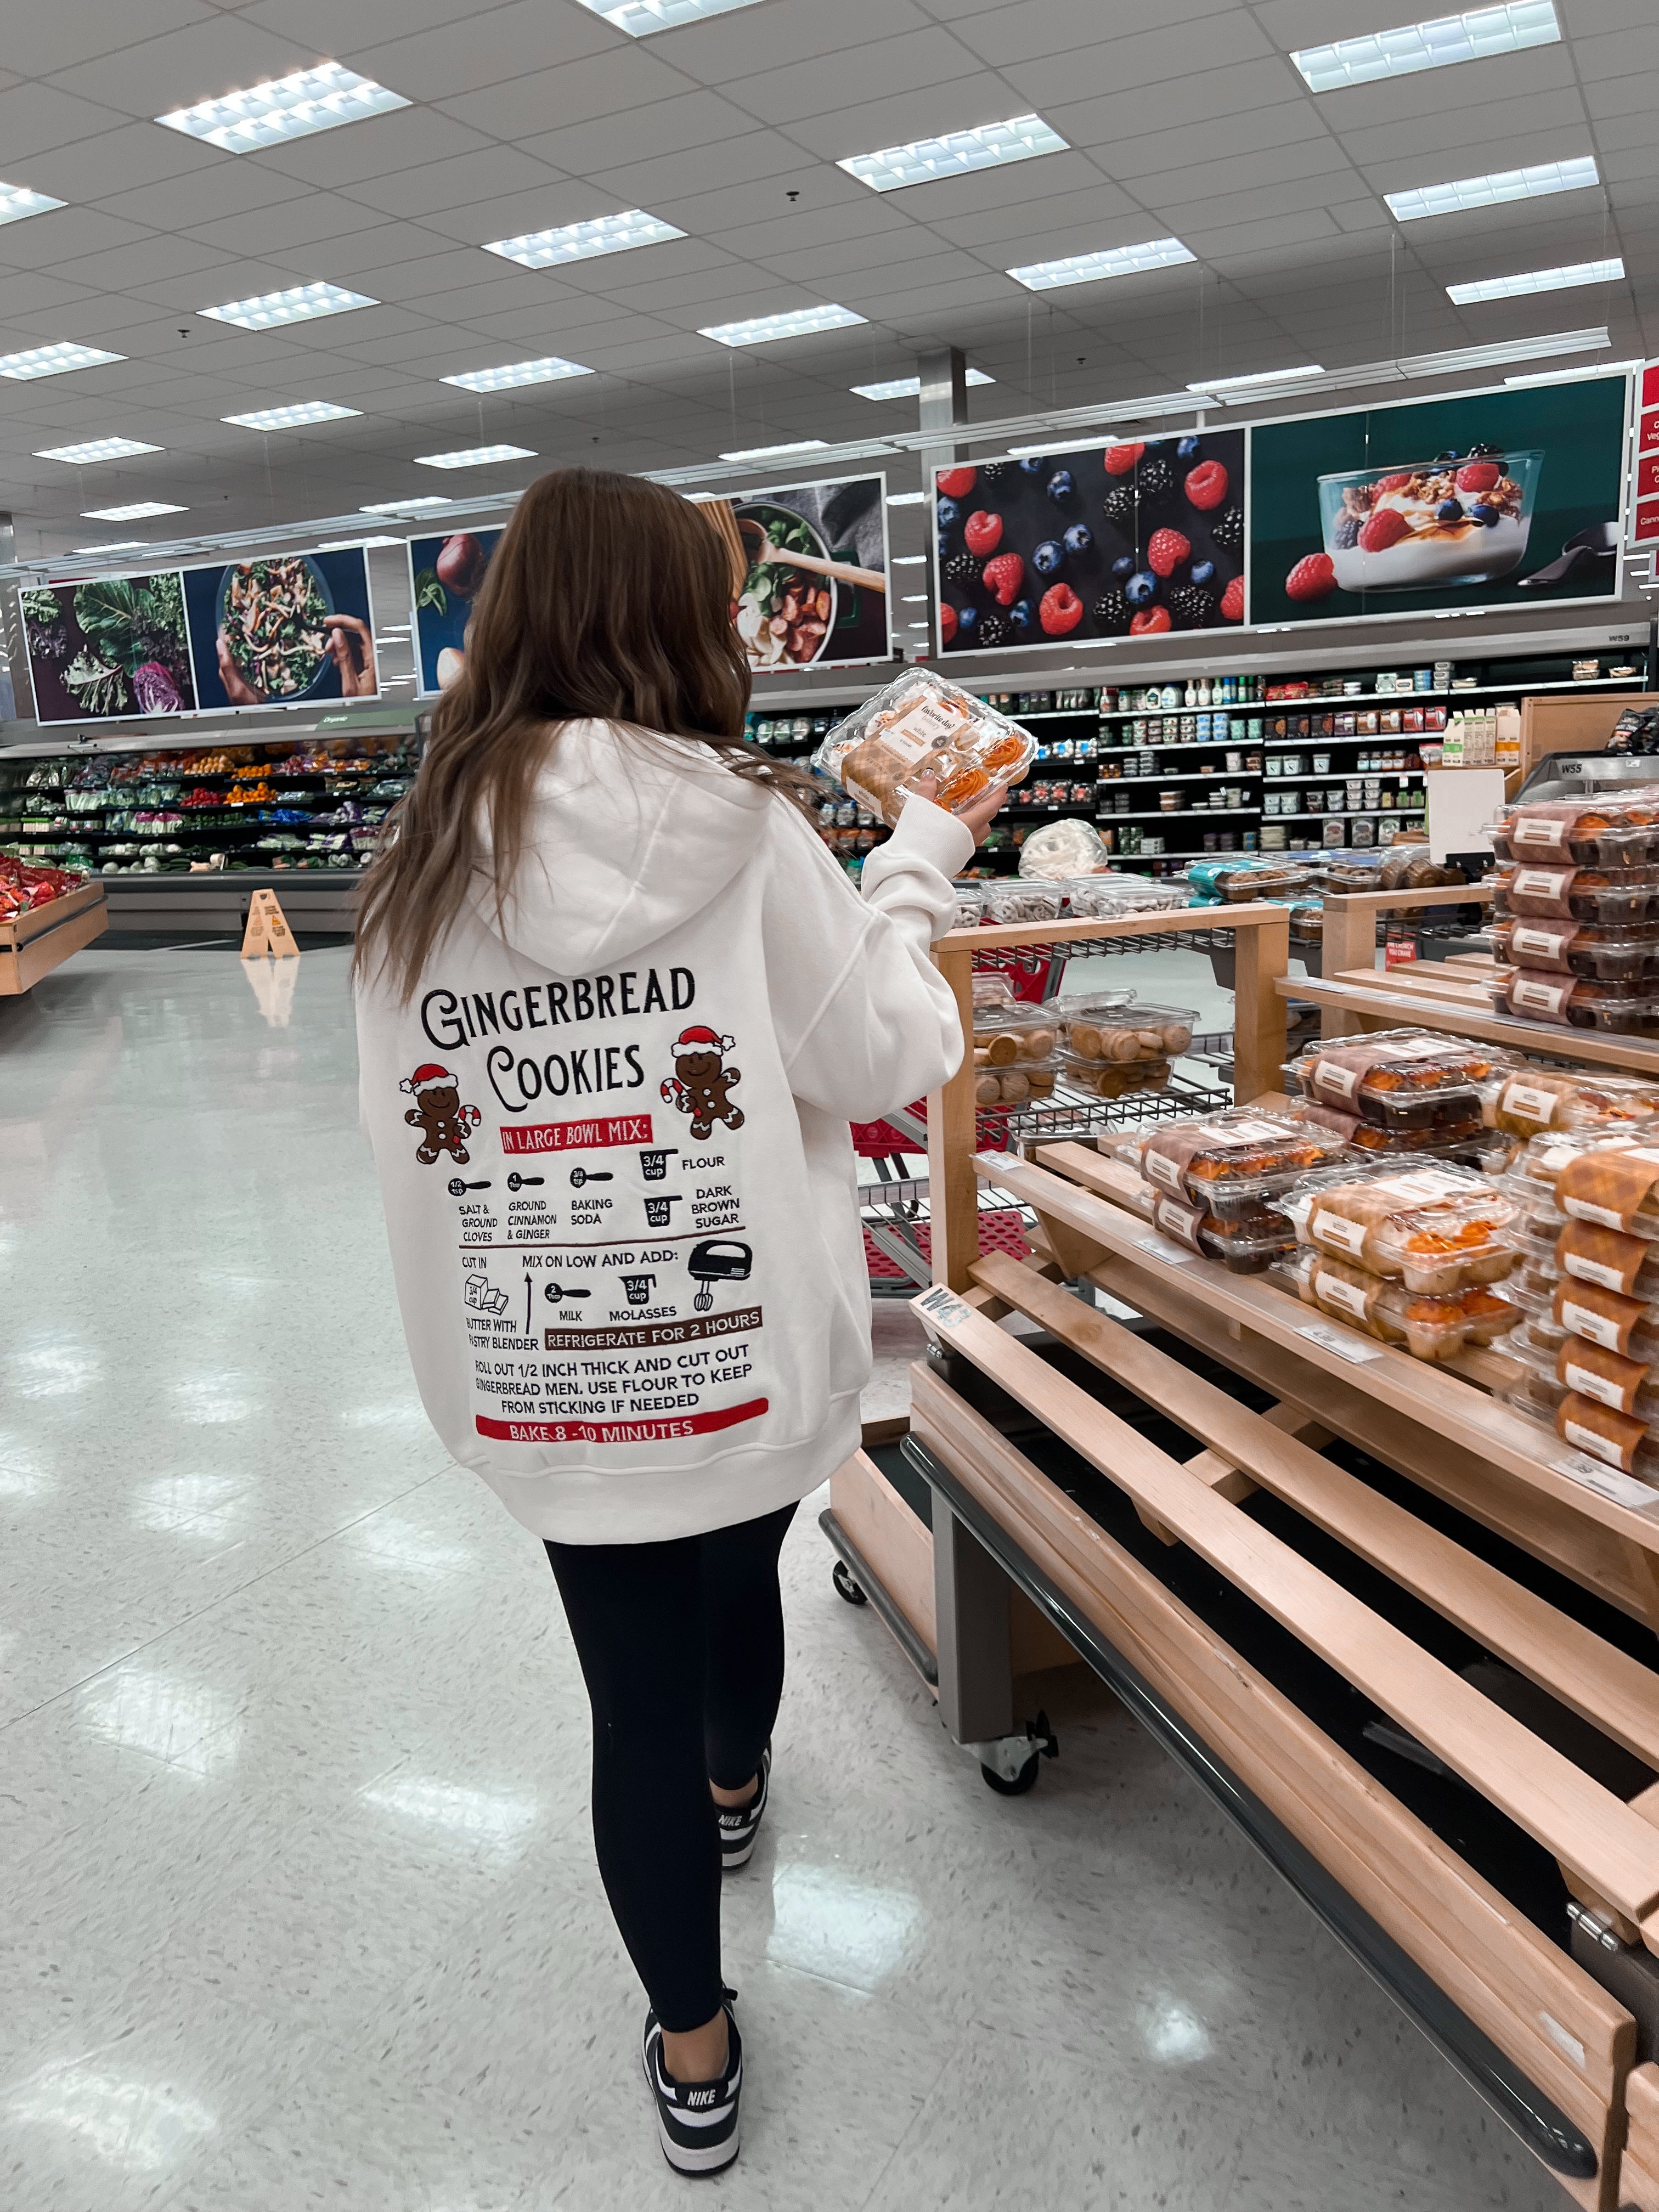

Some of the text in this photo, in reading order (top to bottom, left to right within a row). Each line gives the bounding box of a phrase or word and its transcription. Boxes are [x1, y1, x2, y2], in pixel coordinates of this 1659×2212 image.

[941, 719, 955, 730] day
[1562, 764, 1582, 773] W55
[421, 967, 695, 1050] GINGERBREAD
[487, 1045, 644, 1112] COOKIES
[502, 1119, 648, 1150] IN LARGE BOWL MIX:
[643, 1155, 664, 1167] 3/4
[682, 1156, 725, 1171] FLOUR
[645, 1168, 663, 1177] cup
[696, 1186, 732, 1200] DARK
[459, 1204, 489, 1215] SALT &
[509, 1200, 546, 1211] GROUND
[572, 1199, 613, 1211] BAKING
[647, 1201, 669, 1214] 3/4
[691, 1198, 740, 1215] BROWN
[462, 1217, 498, 1228] GROUND
[508, 1214, 557, 1226] CINNAMON
[571, 1214, 602, 1226] SODA
[650, 1214, 668, 1224] cup
[696, 1214, 740, 1229] SUGAR
[463, 1232, 493, 1242] CLOVES
[507, 1229, 550, 1240] & GINGER
[462, 1256, 487, 1269] CUT IN
[522, 1250, 679, 1268] MIX ON LOW AND ADD:
[626, 1279, 647, 1291] 3/4
[629, 1292, 647, 1302] cup
[560, 1311, 583, 1322] MILK
[609, 1306, 678, 1322] MOLASSES
[493, 1319, 517, 1333] WITH
[548, 1310, 760, 1348] REFRIGERATE FOR 2 HOURS
[493, 1337, 539, 1351] BLENDER
[475, 1344, 749, 1378] ROLL OUT 1/2 INCH THICK AND CUT OUT
[476, 1377, 540, 1395] GINGERBREAD
[588, 1381, 618, 1395] USE
[622, 1377, 679, 1394] FLOUR
[681, 1373, 705, 1388] TO
[710, 1363, 752, 1384] KEEP
[501, 1393, 699, 1414] FROM STICKING IF NEEDED
[509, 1425, 549, 1441] BAKE
[603, 1420, 693, 1442] MINUTES
[719, 1815, 742, 1826] NIKE
[687, 2089, 715, 2106] NIKE
